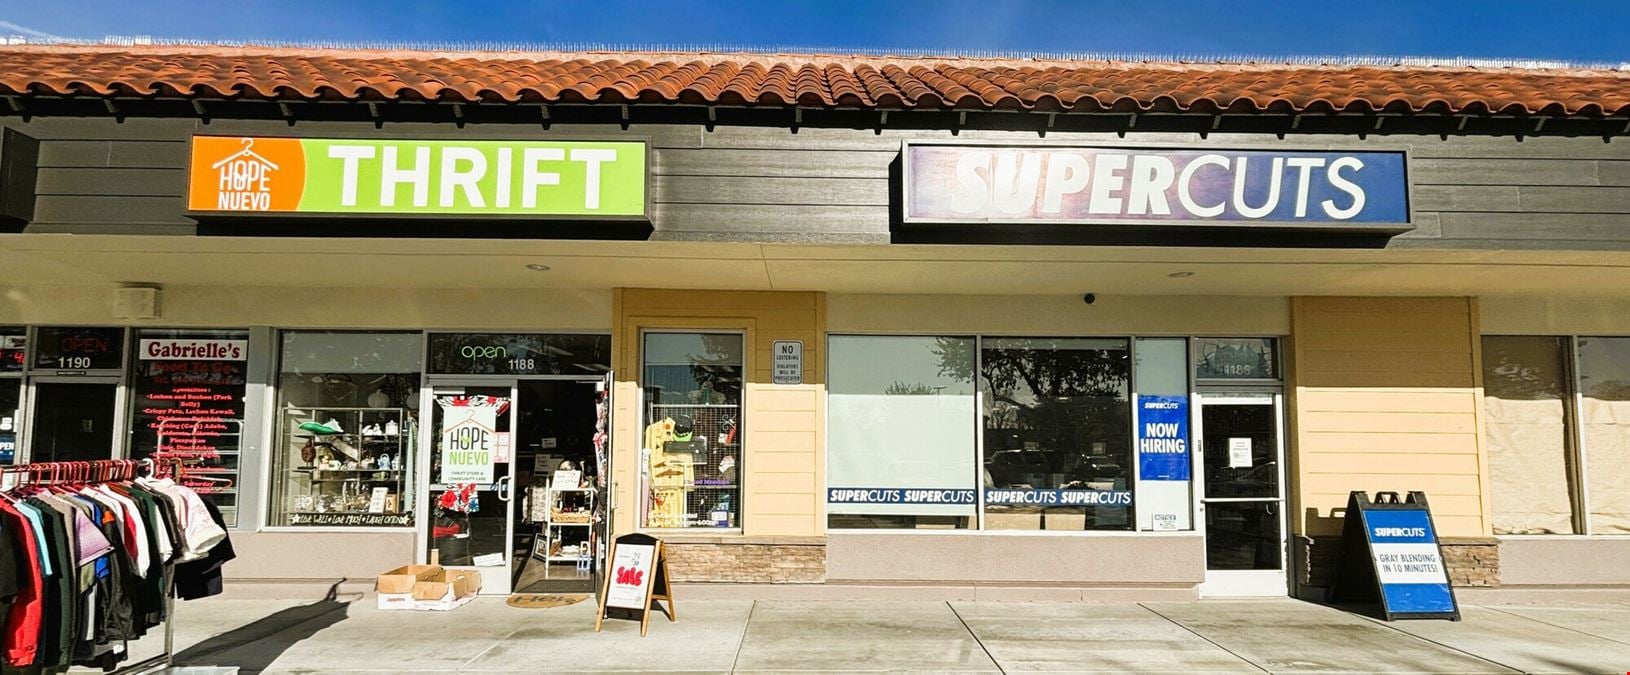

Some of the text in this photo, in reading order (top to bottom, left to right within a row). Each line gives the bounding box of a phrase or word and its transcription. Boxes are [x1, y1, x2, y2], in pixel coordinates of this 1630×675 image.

[219, 159, 271, 191] HOPE
[328, 146, 616, 209] THRIFT
[951, 152, 1365, 220] SUPERCUTS
[218, 192, 270, 211] NUEVO
[148, 342, 240, 358] Gabrielle's
[461, 346, 506, 360] open
[782, 345, 794, 354] NO
[58, 357, 91, 368] 1190
[507, 358, 534, 370] 1188
[1147, 423, 1178, 438] NOW
[449, 427, 488, 450] HOPE
[1141, 439, 1186, 454] HIRING
[448, 452, 489, 465] NUEVO
[830, 490, 975, 503] SUPERCUTS SUPERCUTS
[986, 491, 1131, 504] SUPERCUTS SUPERCUTS
[1374, 527, 1425, 537] SUPERCUTS
[1379, 554, 1436, 562] GRAY BLENDING
[1383, 564, 1438, 572] IN 10 MINUTES!
[616, 566, 643, 586] SALE
